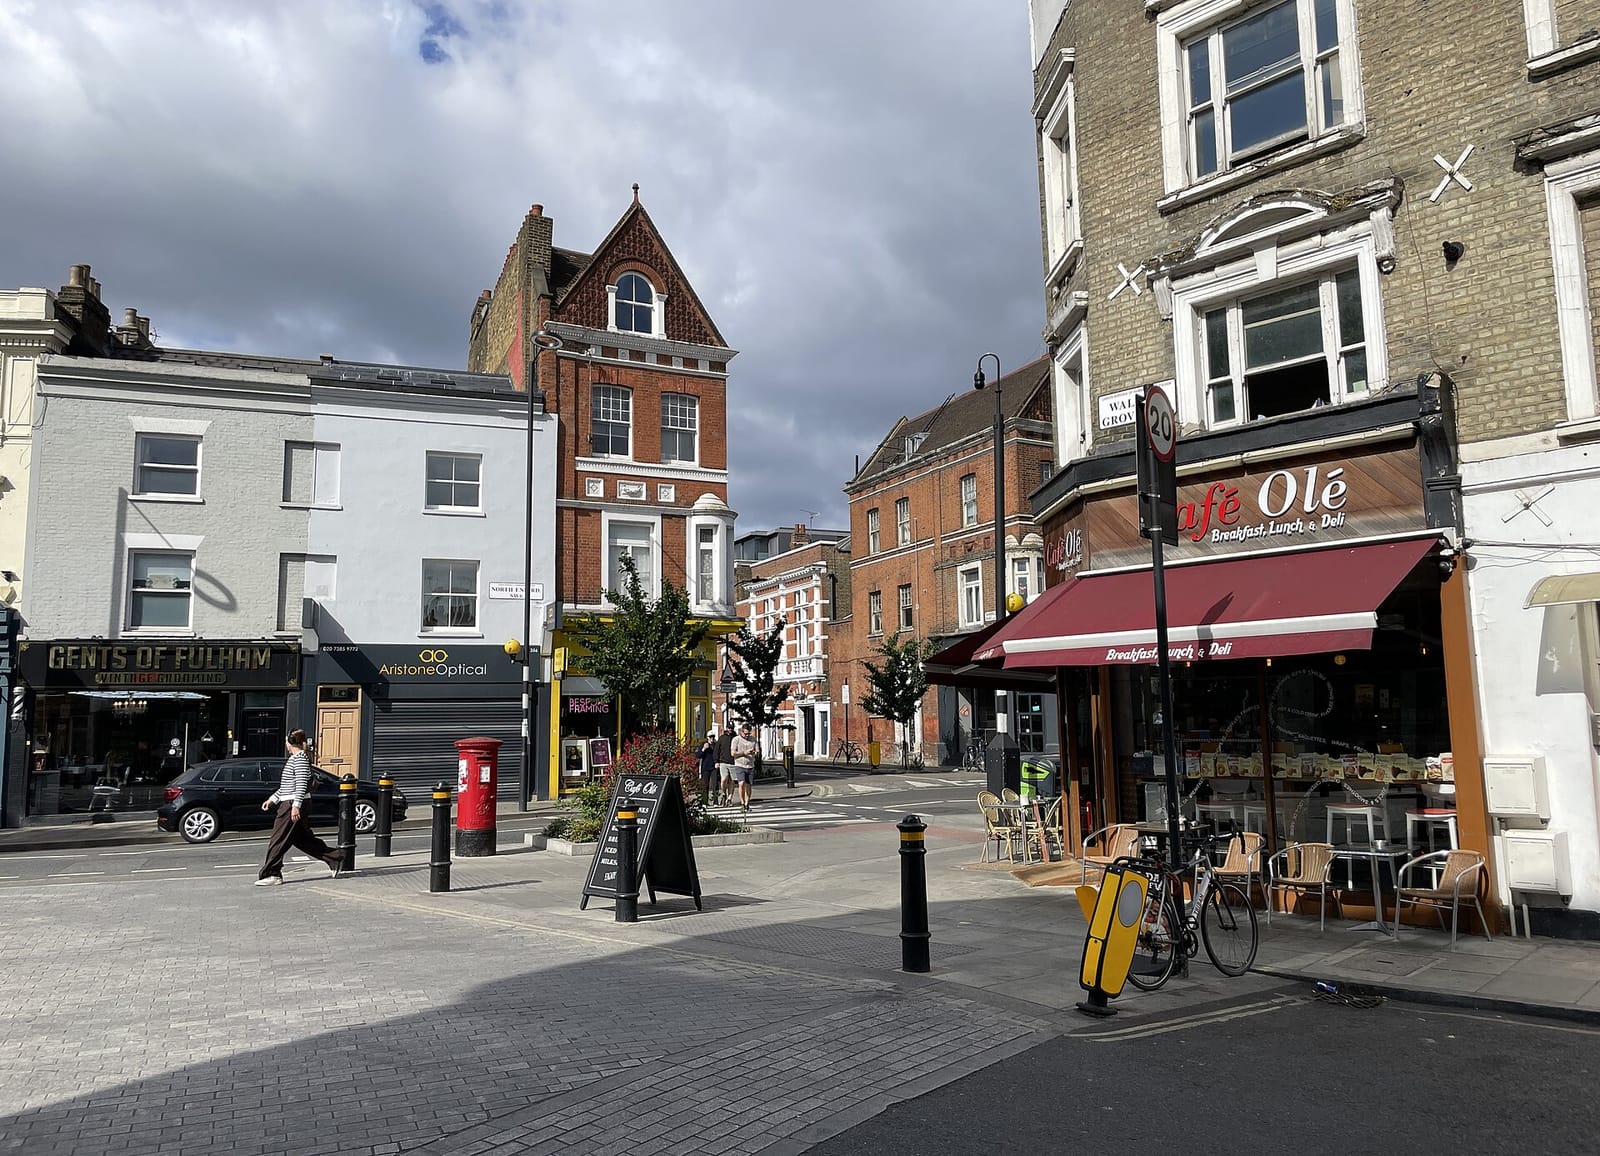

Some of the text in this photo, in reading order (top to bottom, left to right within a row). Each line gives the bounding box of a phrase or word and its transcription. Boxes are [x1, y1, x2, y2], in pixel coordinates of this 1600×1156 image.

[1109, 399, 1134, 412] WAL
[1102, 412, 1135, 427] GROV
[1150, 405, 1172, 442] 20
[1176, 467, 1349, 543] afé Olé
[1211, 511, 1346, 544] Breakfast, Lunch & Deli
[1066, 528, 1082, 557] Olé
[48, 645, 272, 670] GENTS OF FULHAM
[1168, 645, 1194, 663] unch
[1198, 648, 1206, 660] &
[1208, 641, 1232, 656] Deli
[100, 673, 222, 683] VINTAGE GROOMING
[379, 663, 487, 678] AristoneOptical
[569, 704, 609, 713] FRAMING
